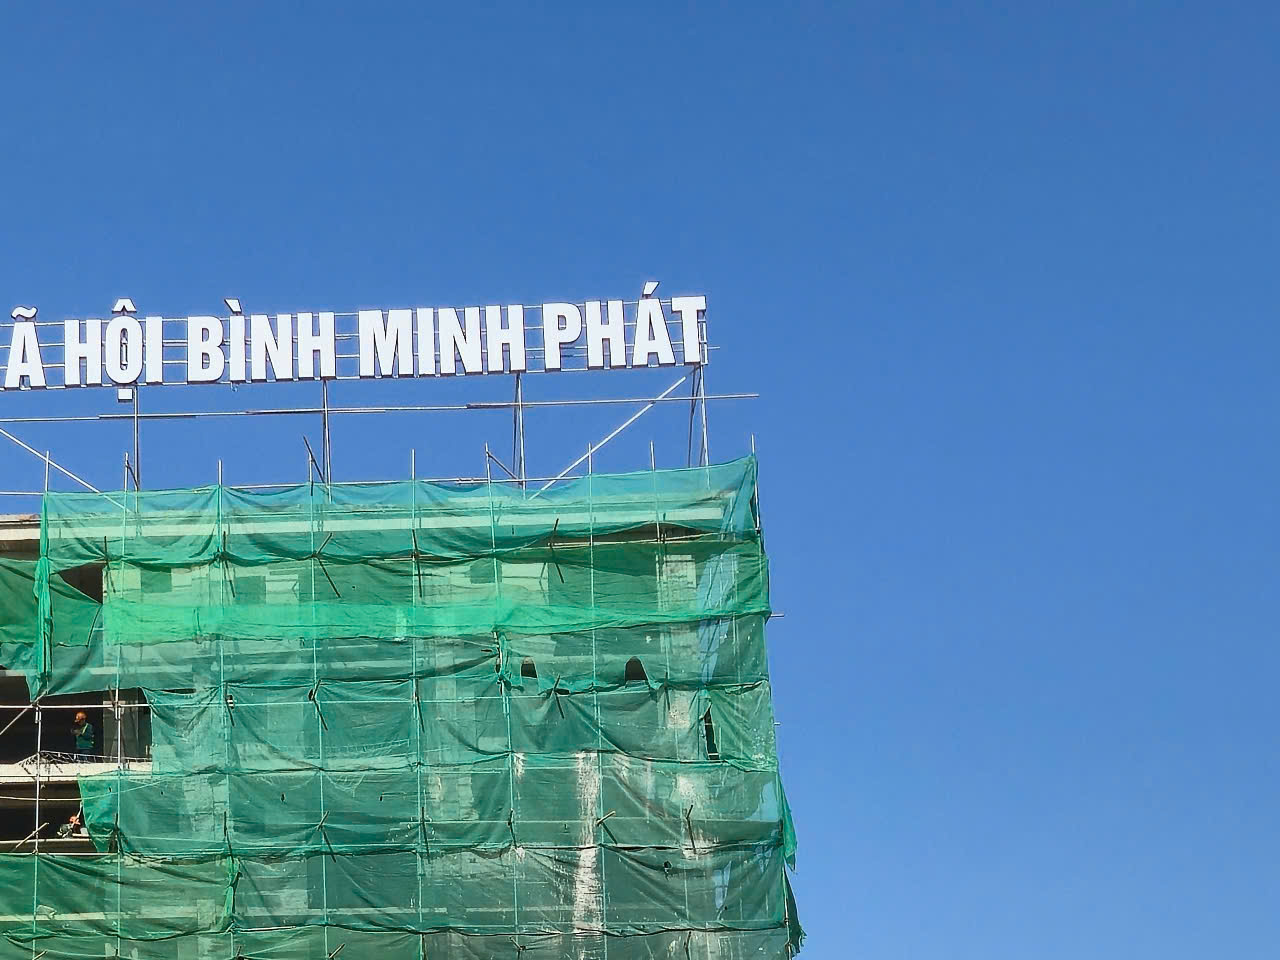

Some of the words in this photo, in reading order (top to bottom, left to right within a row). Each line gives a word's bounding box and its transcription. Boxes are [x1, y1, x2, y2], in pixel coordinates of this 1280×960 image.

[64, 298, 163, 401] HỘI
[187, 298, 336, 383] BÌNH
[358, 304, 526, 379] MINH
[542, 281, 707, 371] PHÁT
